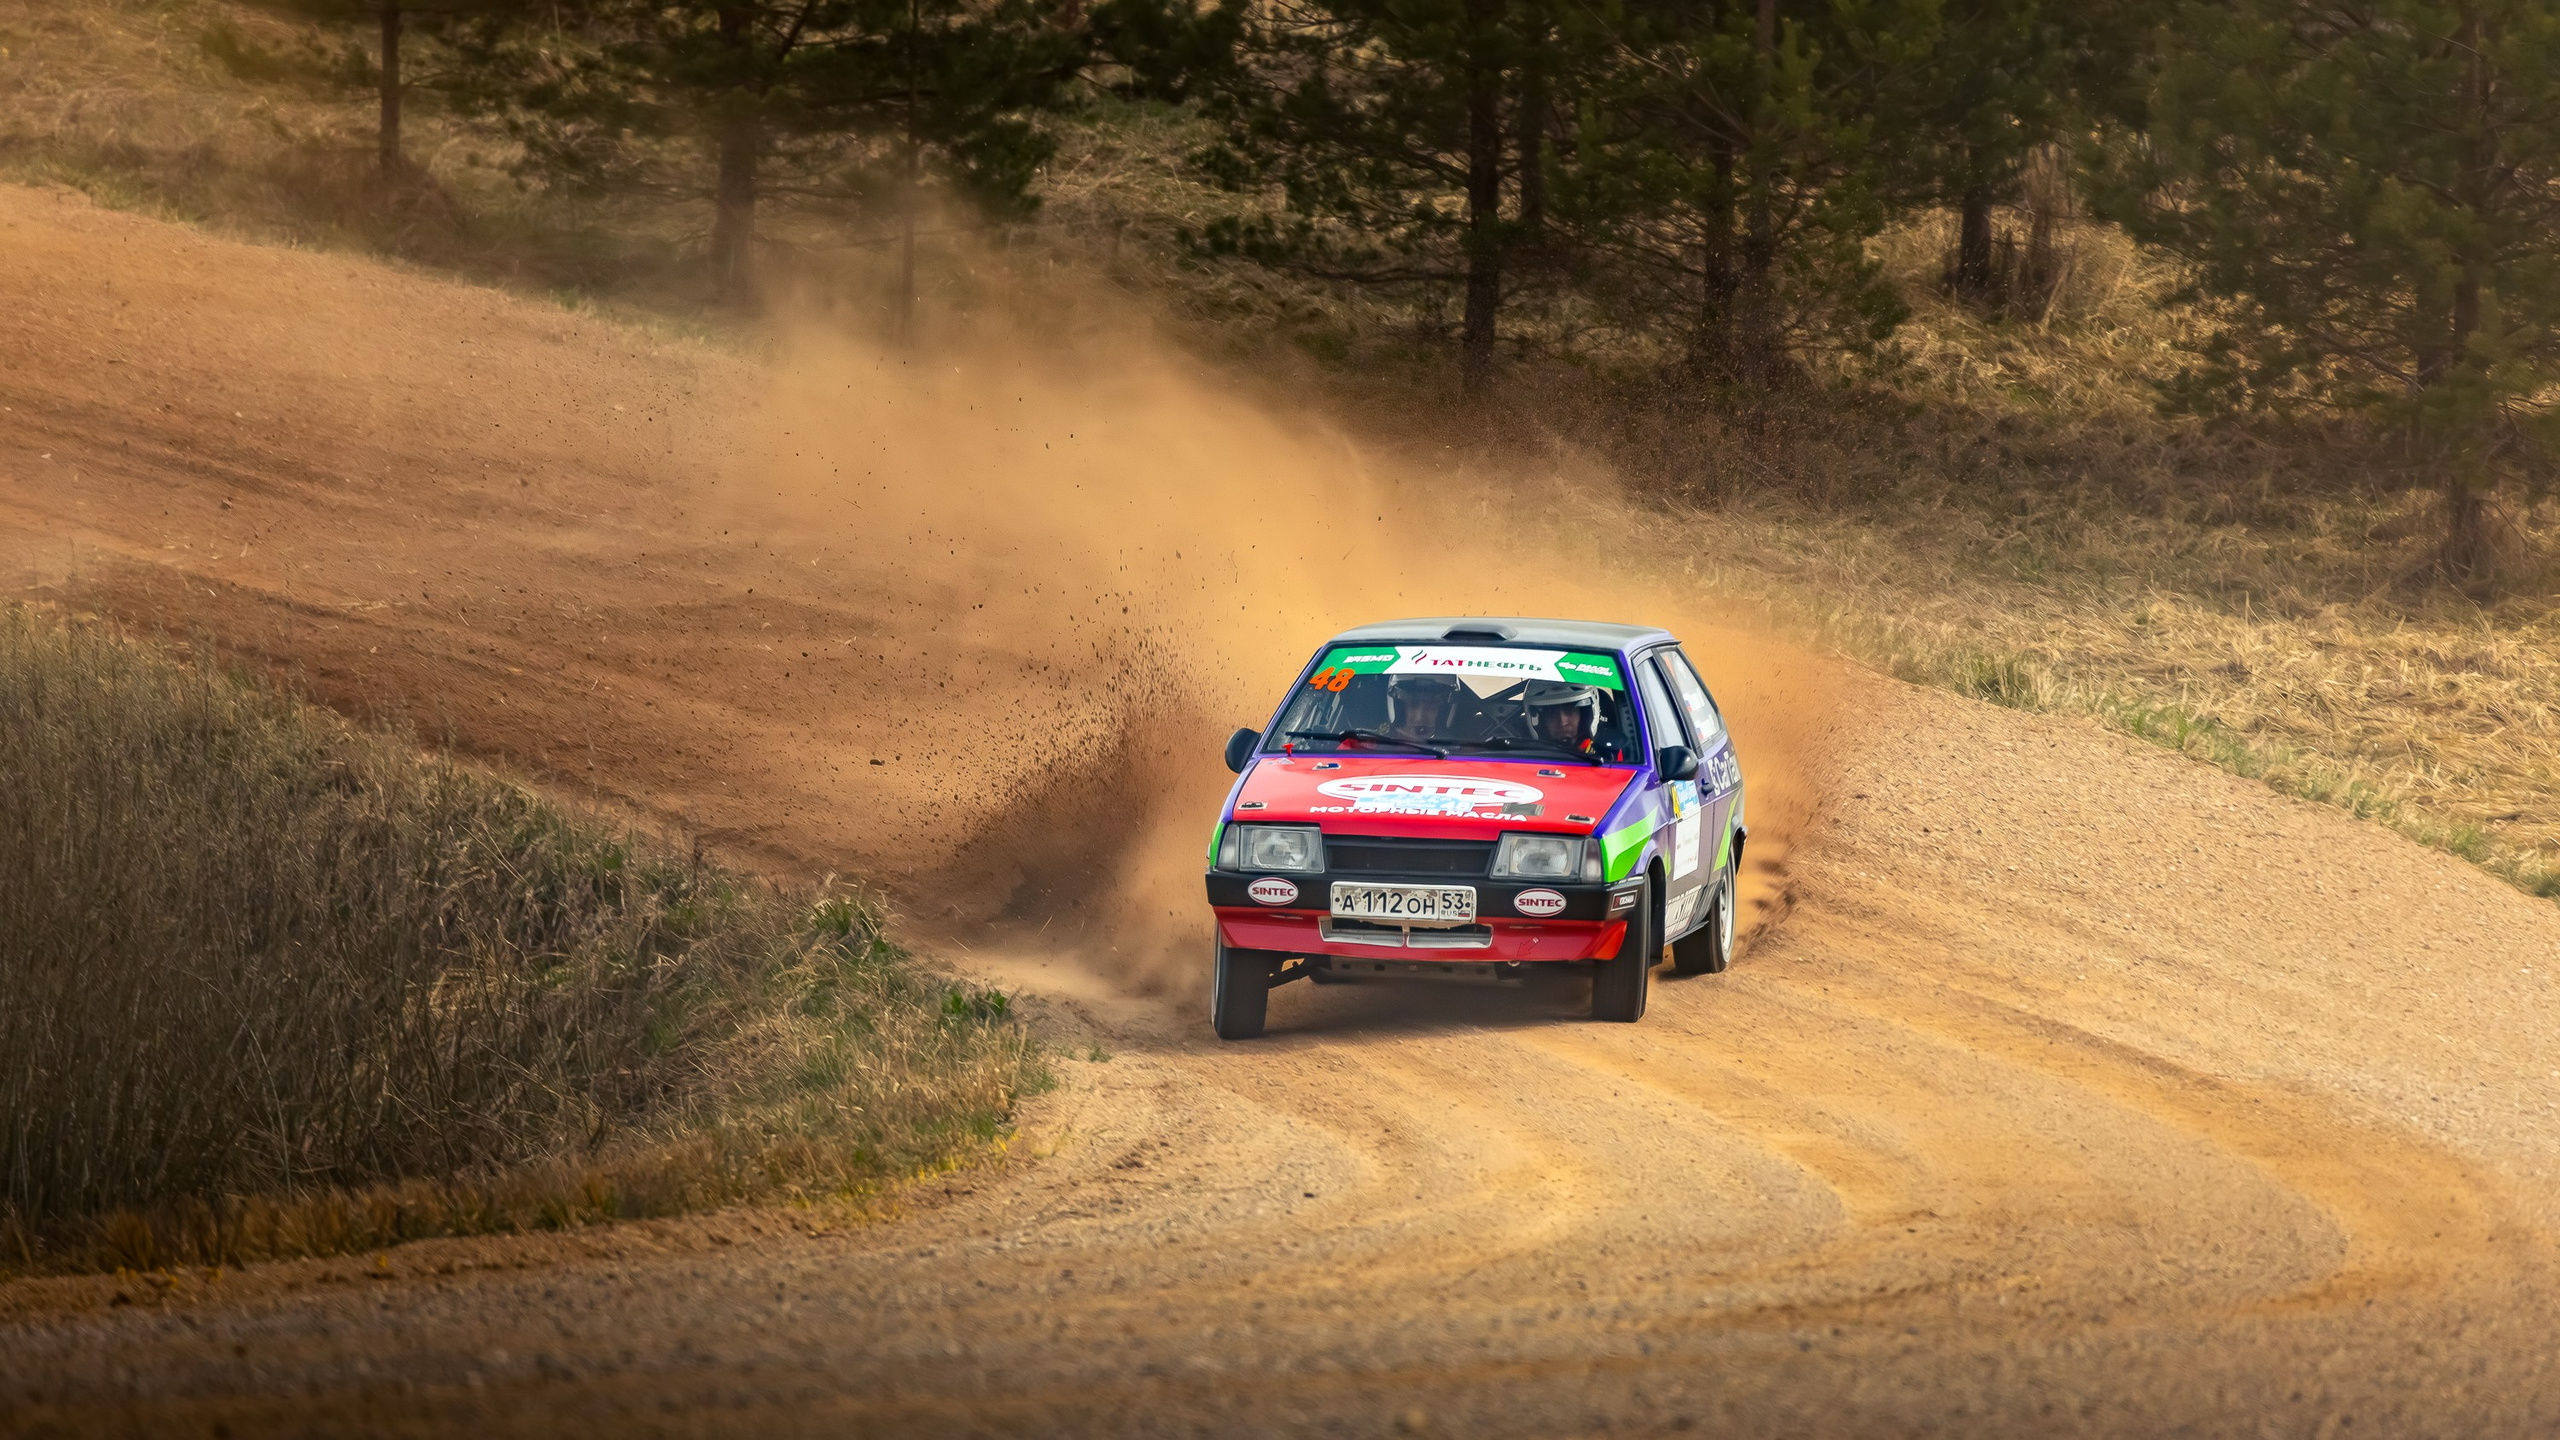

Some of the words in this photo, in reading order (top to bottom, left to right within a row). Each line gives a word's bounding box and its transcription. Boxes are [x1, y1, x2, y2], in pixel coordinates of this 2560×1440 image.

[1430, 659, 1542, 672] ТАТНЕФТЬ
[1309, 666, 1355, 692] 48
[1338, 783, 1526, 799] SINTEC
[1310, 806, 1440, 816] МОТОРНЫЕ
[1445, 810, 1528, 821] МАСЛА
[1252, 886, 1295, 897] SINTEC
[1442, 893, 1464, 909] 53
[1518, 898, 1562, 907] SINTEC
